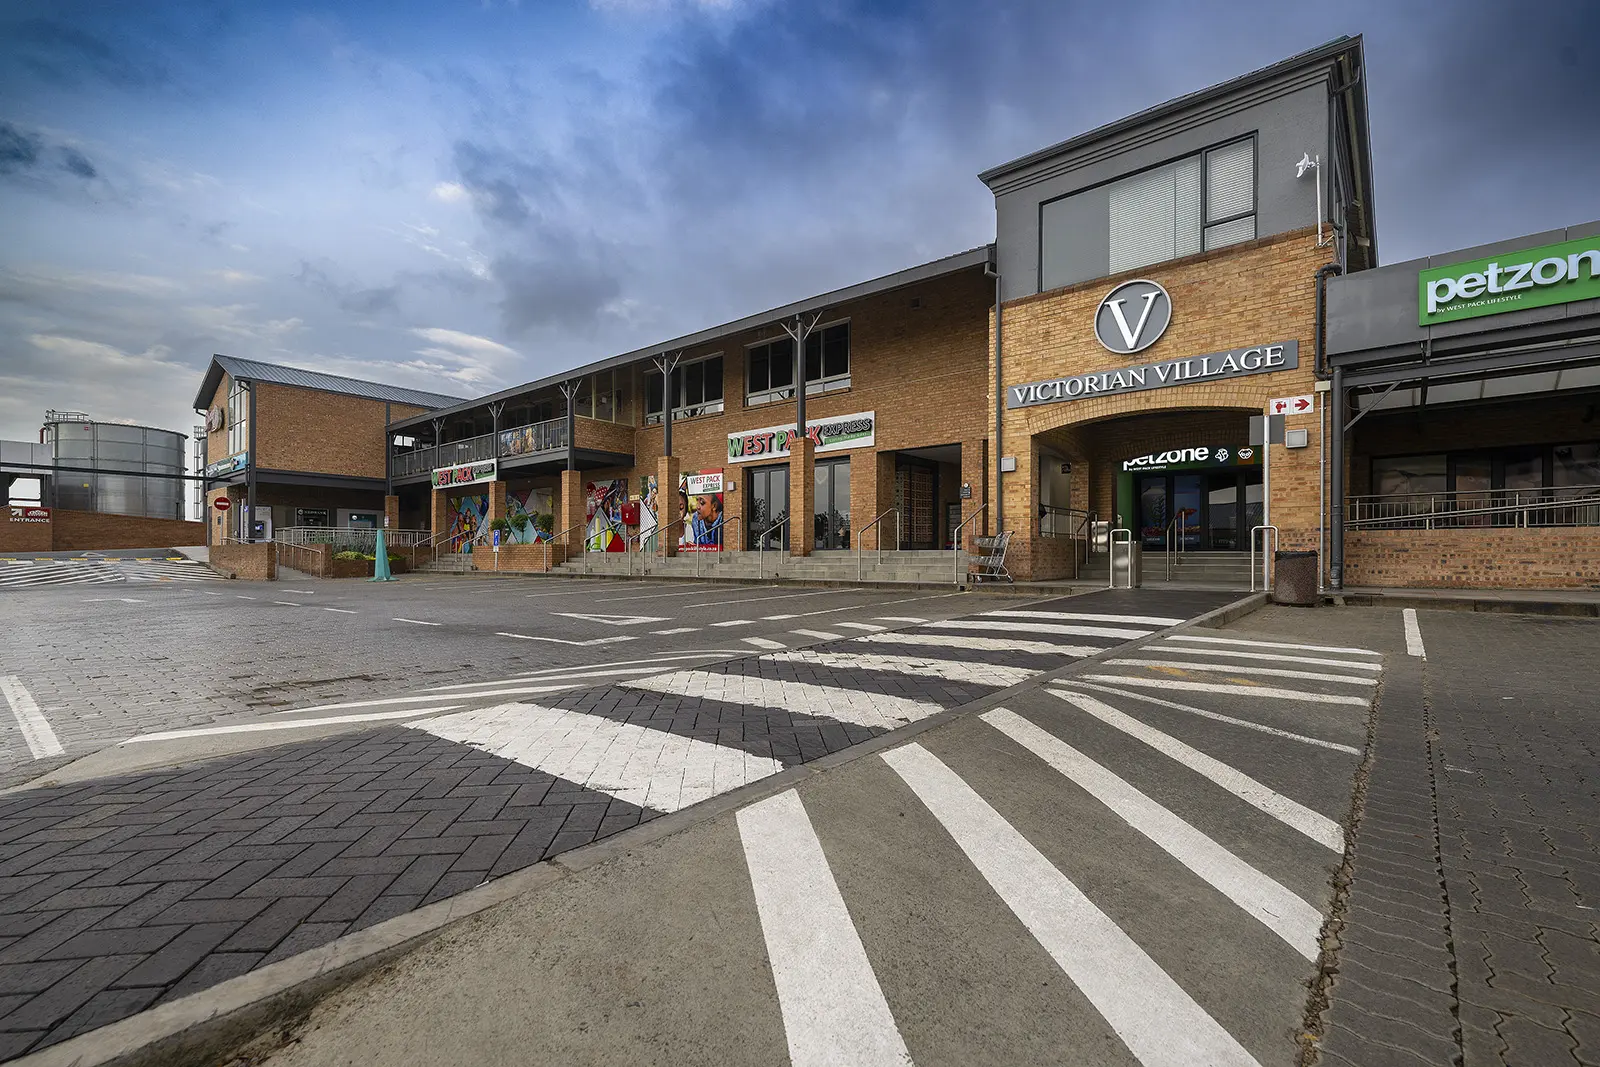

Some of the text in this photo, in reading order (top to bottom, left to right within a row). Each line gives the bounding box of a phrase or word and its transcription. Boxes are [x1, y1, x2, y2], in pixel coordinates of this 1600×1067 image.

[1446, 304, 1466, 312] WEST
[1467, 300, 1486, 308] PACK
[1487, 294, 1522, 305] LIFESTYLE
[1104, 291, 1161, 350] V
[1013, 345, 1286, 405] VICTORIAN VILLAGE
[728, 432, 775, 458] WEST
[775, 425, 823, 452] PAK
[823, 418, 873, 437] EXPRESS
[431, 469, 452, 486] WEST
[452, 466, 474, 483] PACK
[690, 475, 721, 485] WEST PACK
